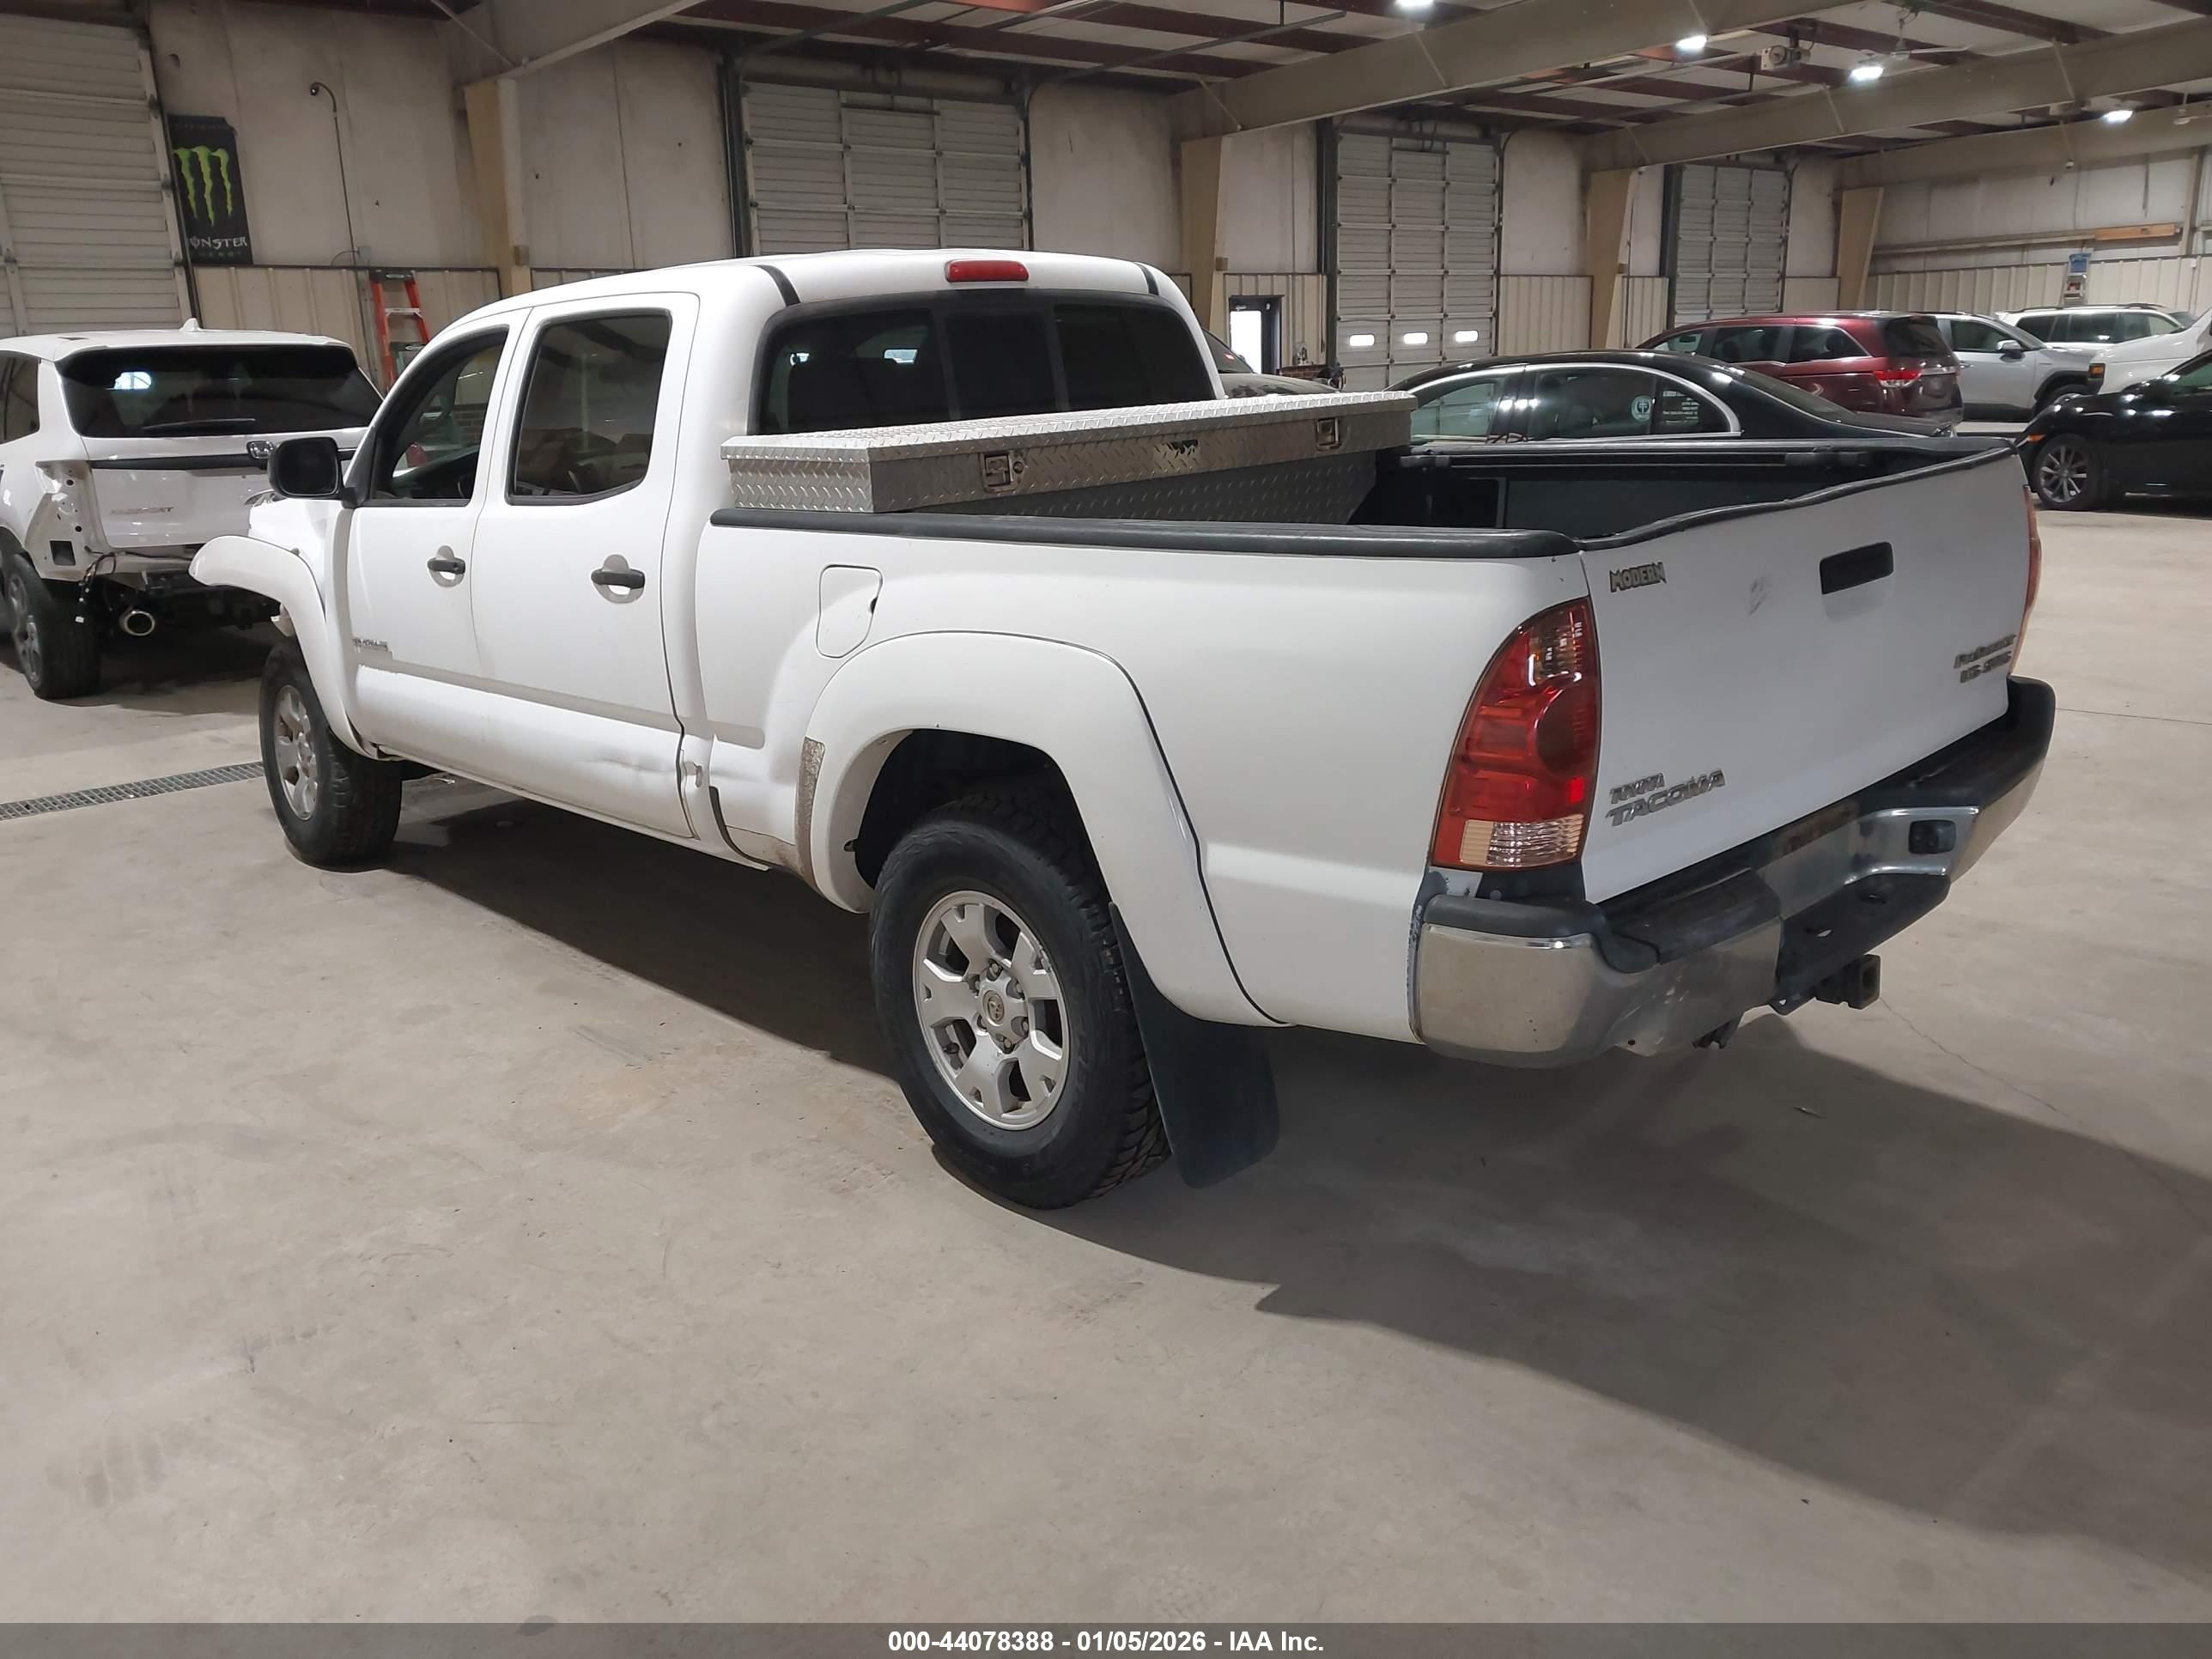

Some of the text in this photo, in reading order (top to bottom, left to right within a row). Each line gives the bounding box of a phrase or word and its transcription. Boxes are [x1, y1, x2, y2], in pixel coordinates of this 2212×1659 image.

[190, 236, 247, 250] ONSTER
[1609, 562, 1667, 592] MODERN
[1605, 769, 1726, 826] TACOMA
